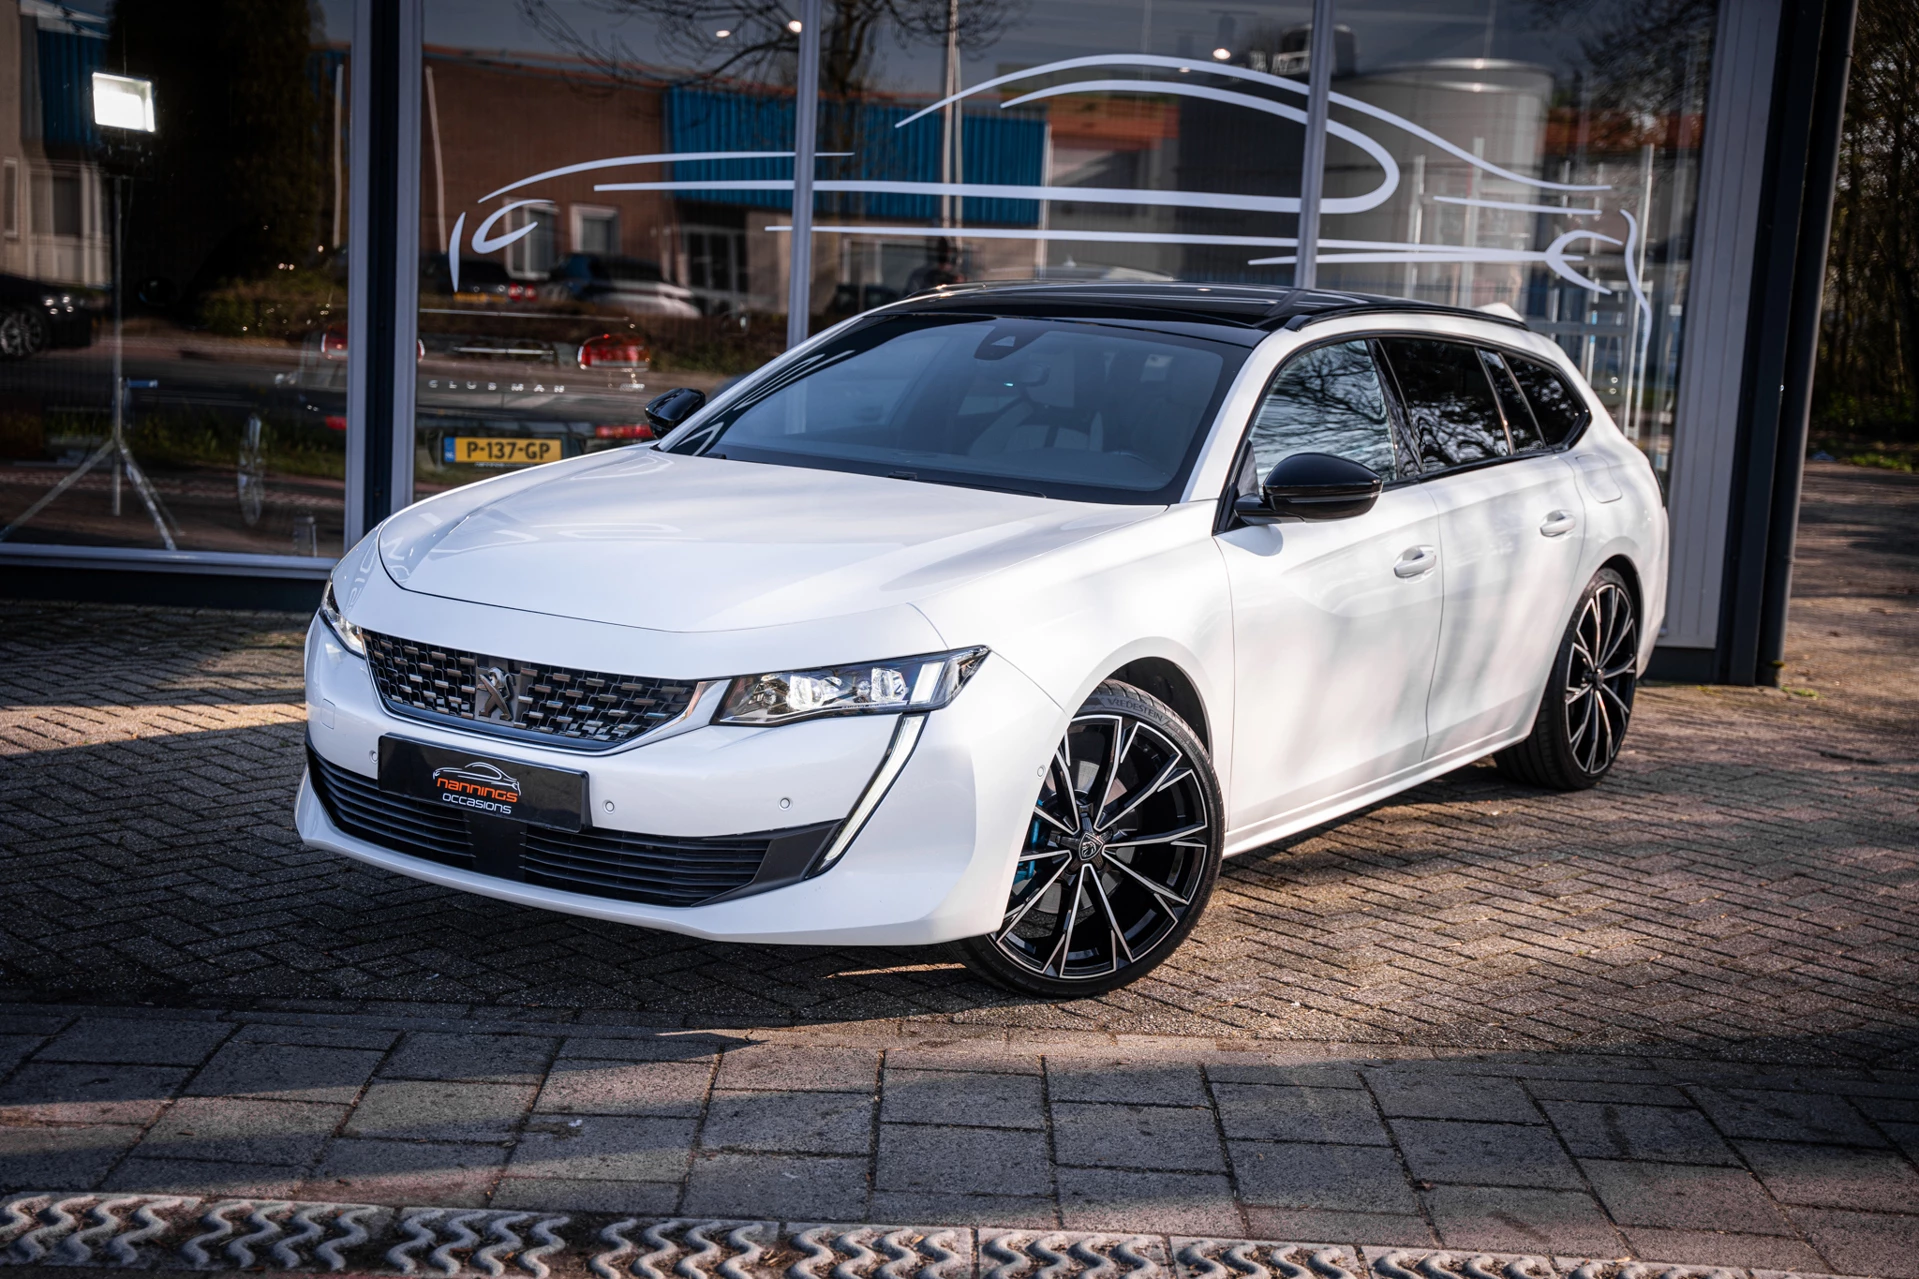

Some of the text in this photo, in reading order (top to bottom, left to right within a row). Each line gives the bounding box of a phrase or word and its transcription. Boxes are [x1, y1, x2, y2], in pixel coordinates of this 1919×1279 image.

[428, 380, 565, 393] CLUBMAN
[467, 441, 551, 460] P-137-GP
[1107, 697, 1163, 721] VREDESTEIN
[437, 777, 518, 803] nannings
[442, 793, 512, 815] occasions
